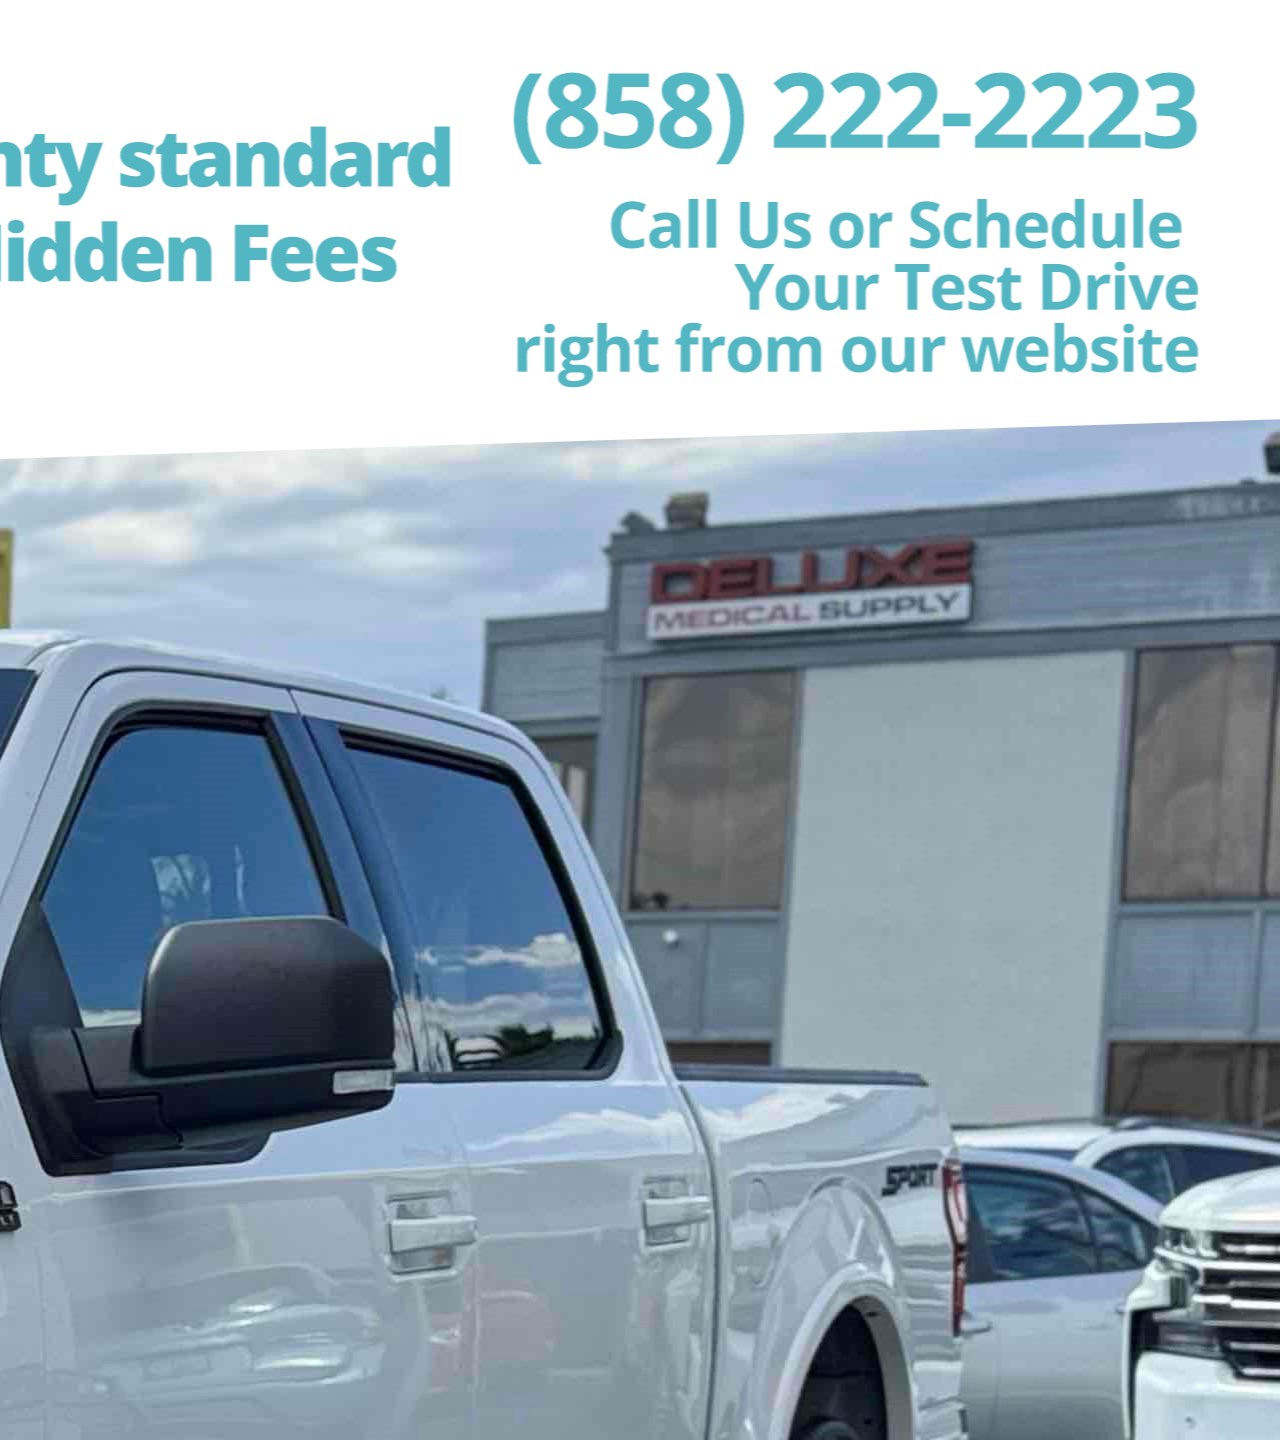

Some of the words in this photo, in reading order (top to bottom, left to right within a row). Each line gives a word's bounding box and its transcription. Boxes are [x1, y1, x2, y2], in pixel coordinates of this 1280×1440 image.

[650, 537, 974, 605] DELUXE
[654, 603, 811, 631] MEDICAL
[818, 591, 960, 621] SUPPLY
[881, 1163, 938, 1196] SPORT
